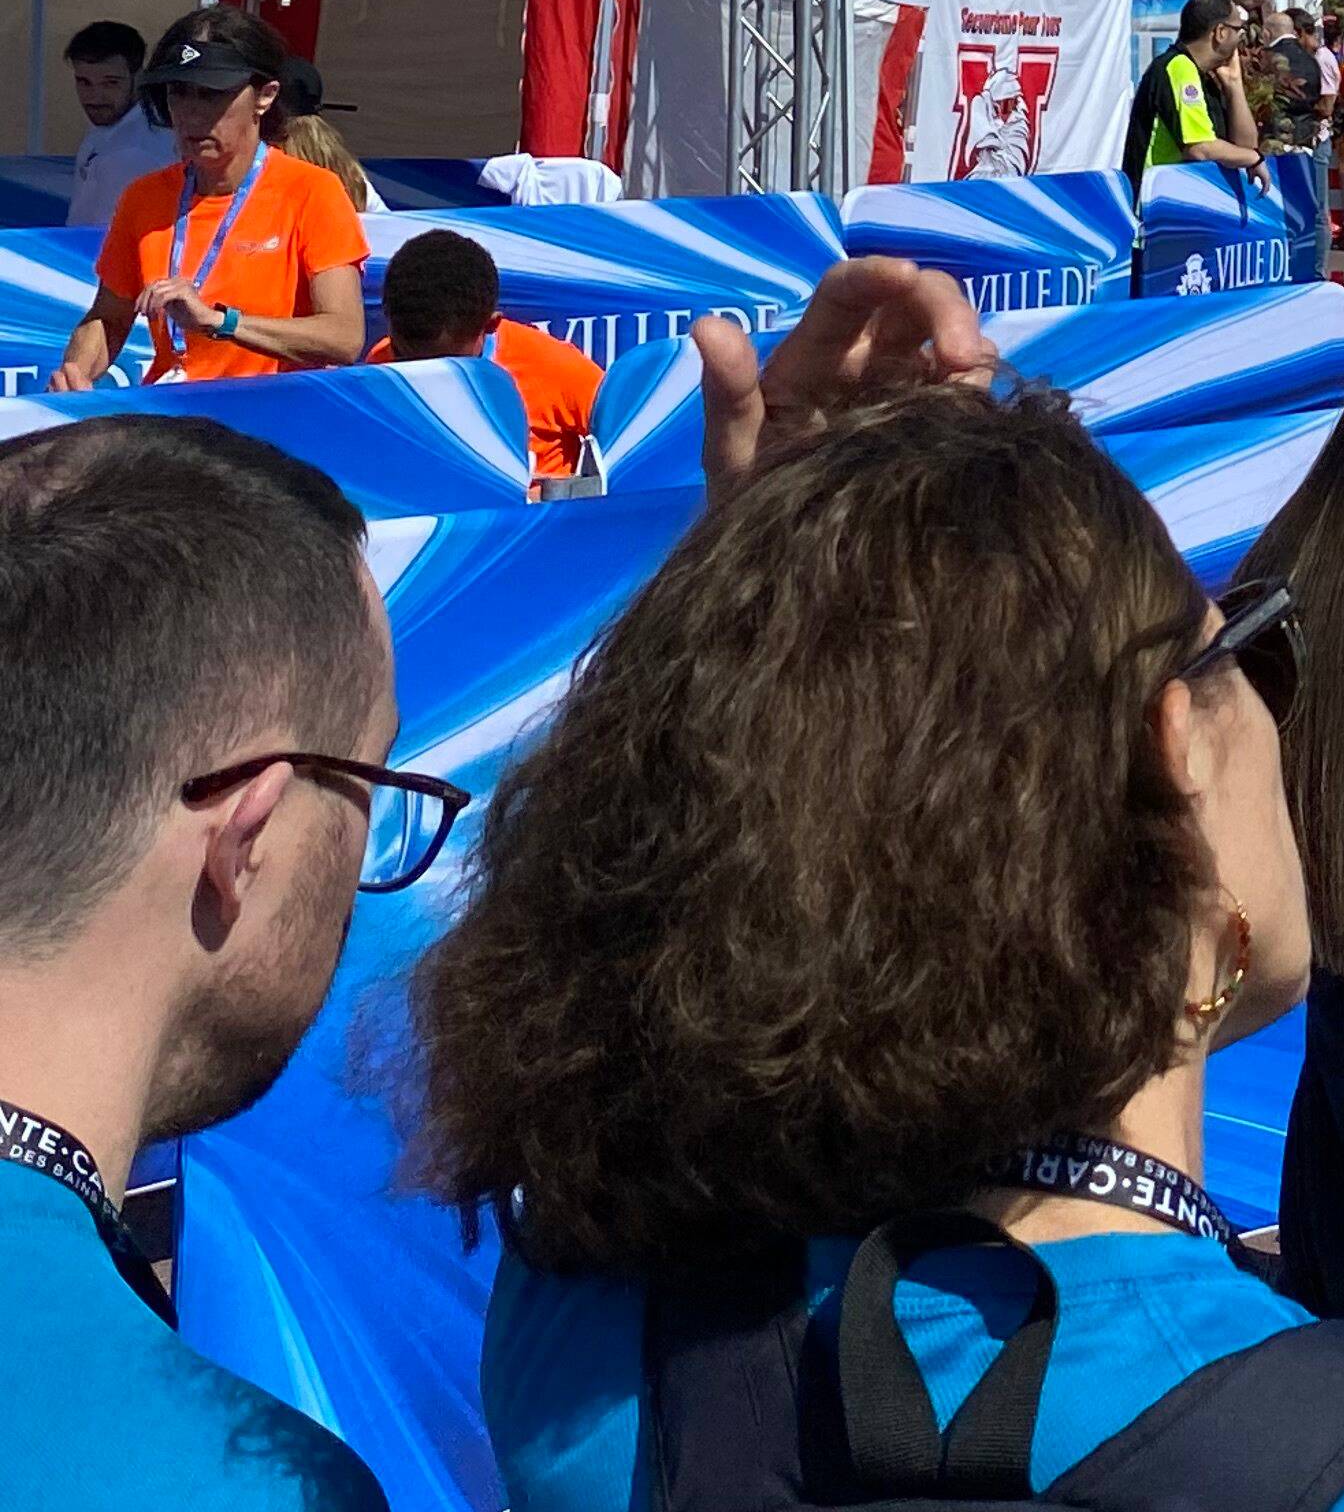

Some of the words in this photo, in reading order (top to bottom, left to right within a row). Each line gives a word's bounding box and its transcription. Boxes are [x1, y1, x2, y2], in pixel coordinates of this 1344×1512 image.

[1215, 243, 1266, 291] VILLE
[1270, 238, 1293, 282] DE
[9, 1144, 48, 1169] DES
[52, 1162, 99, 1207] BAINS
[1144, 1158, 1179, 1184] DES
